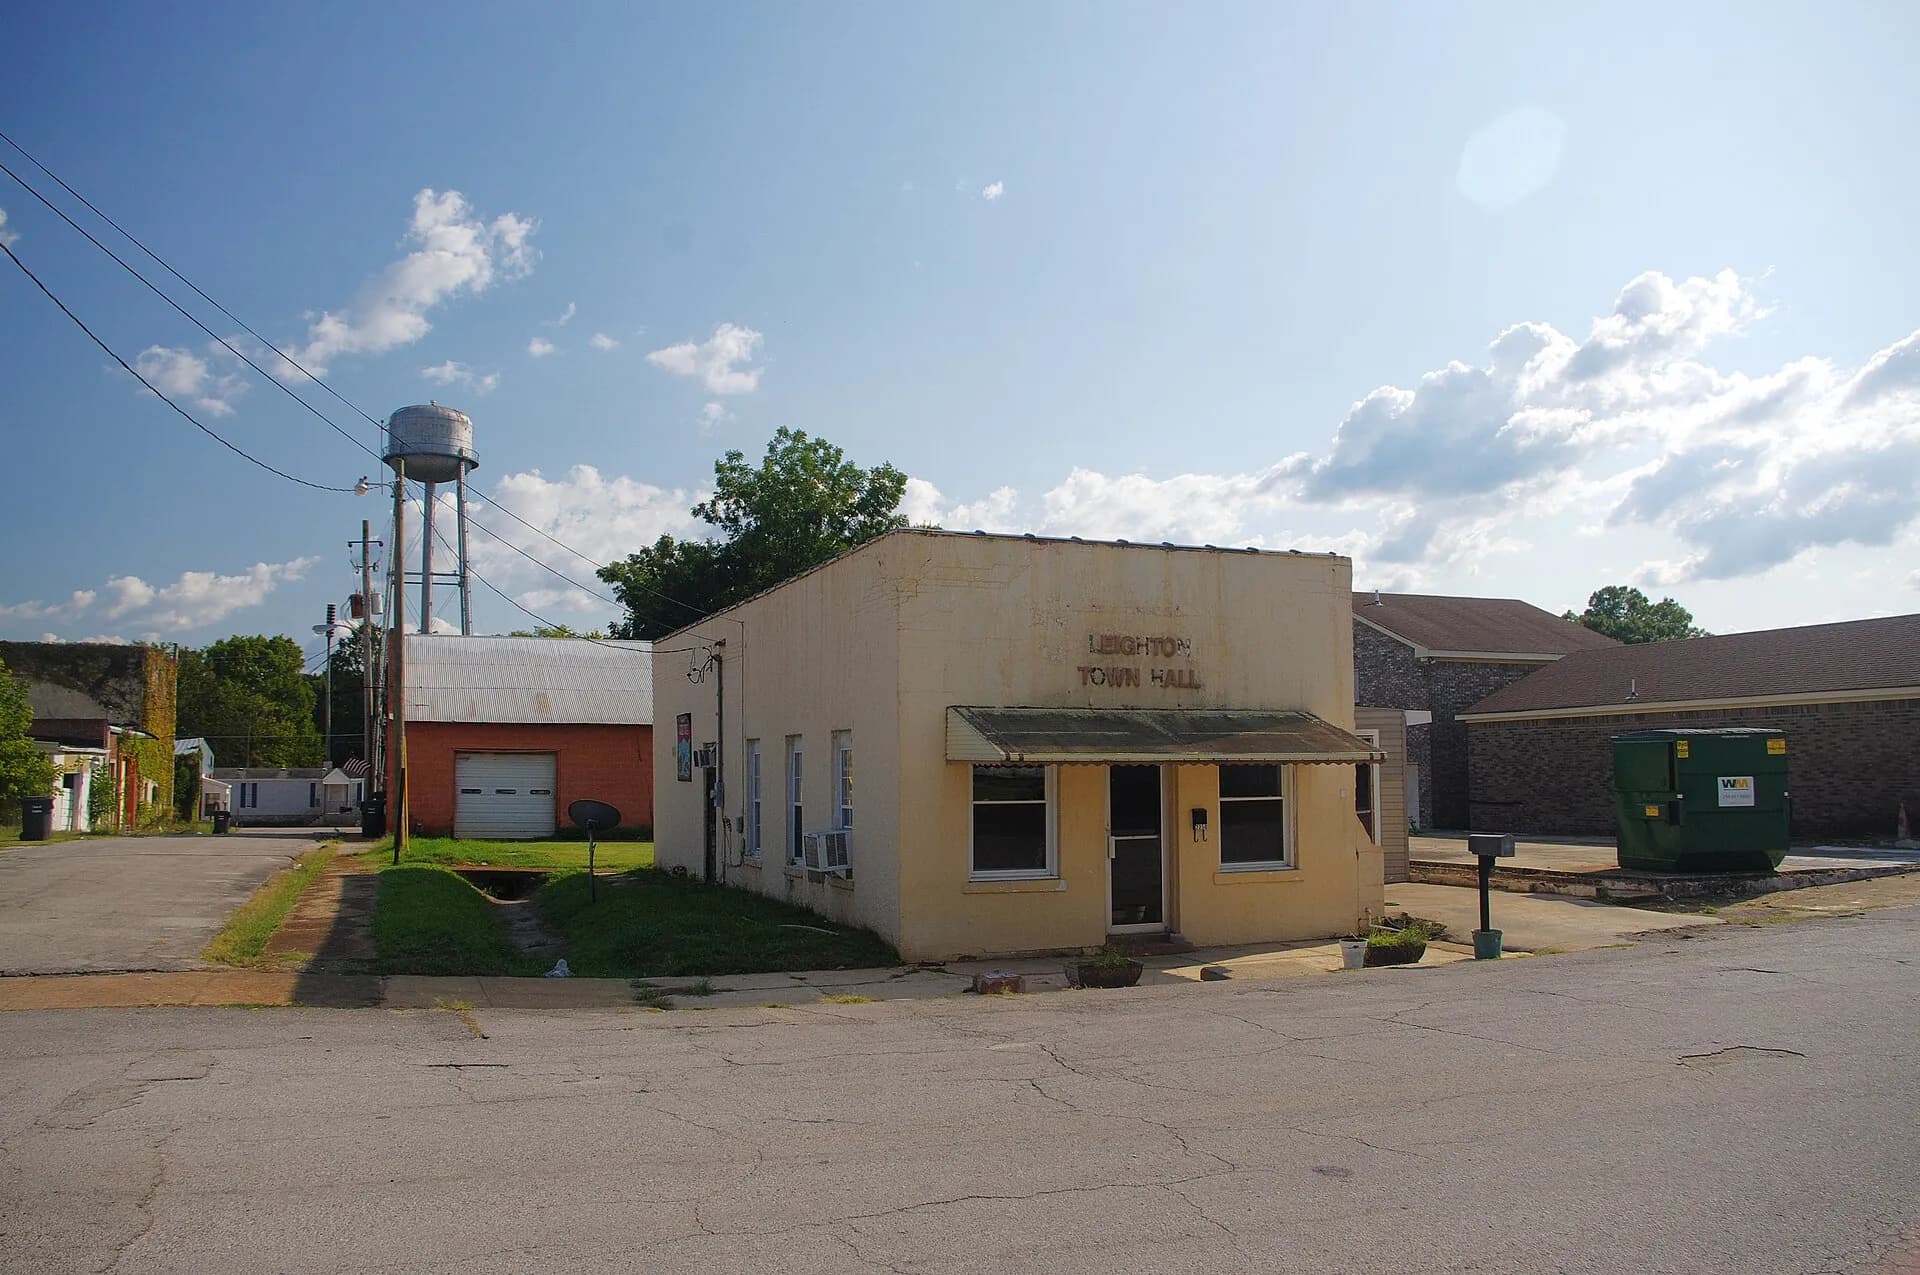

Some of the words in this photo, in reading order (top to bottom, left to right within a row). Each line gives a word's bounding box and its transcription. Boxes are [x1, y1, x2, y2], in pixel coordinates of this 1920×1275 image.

[1089, 634, 1191, 657] LEIGHTON
[1077, 666, 1141, 688] TOWN
[1151, 668, 1202, 690] HALL
